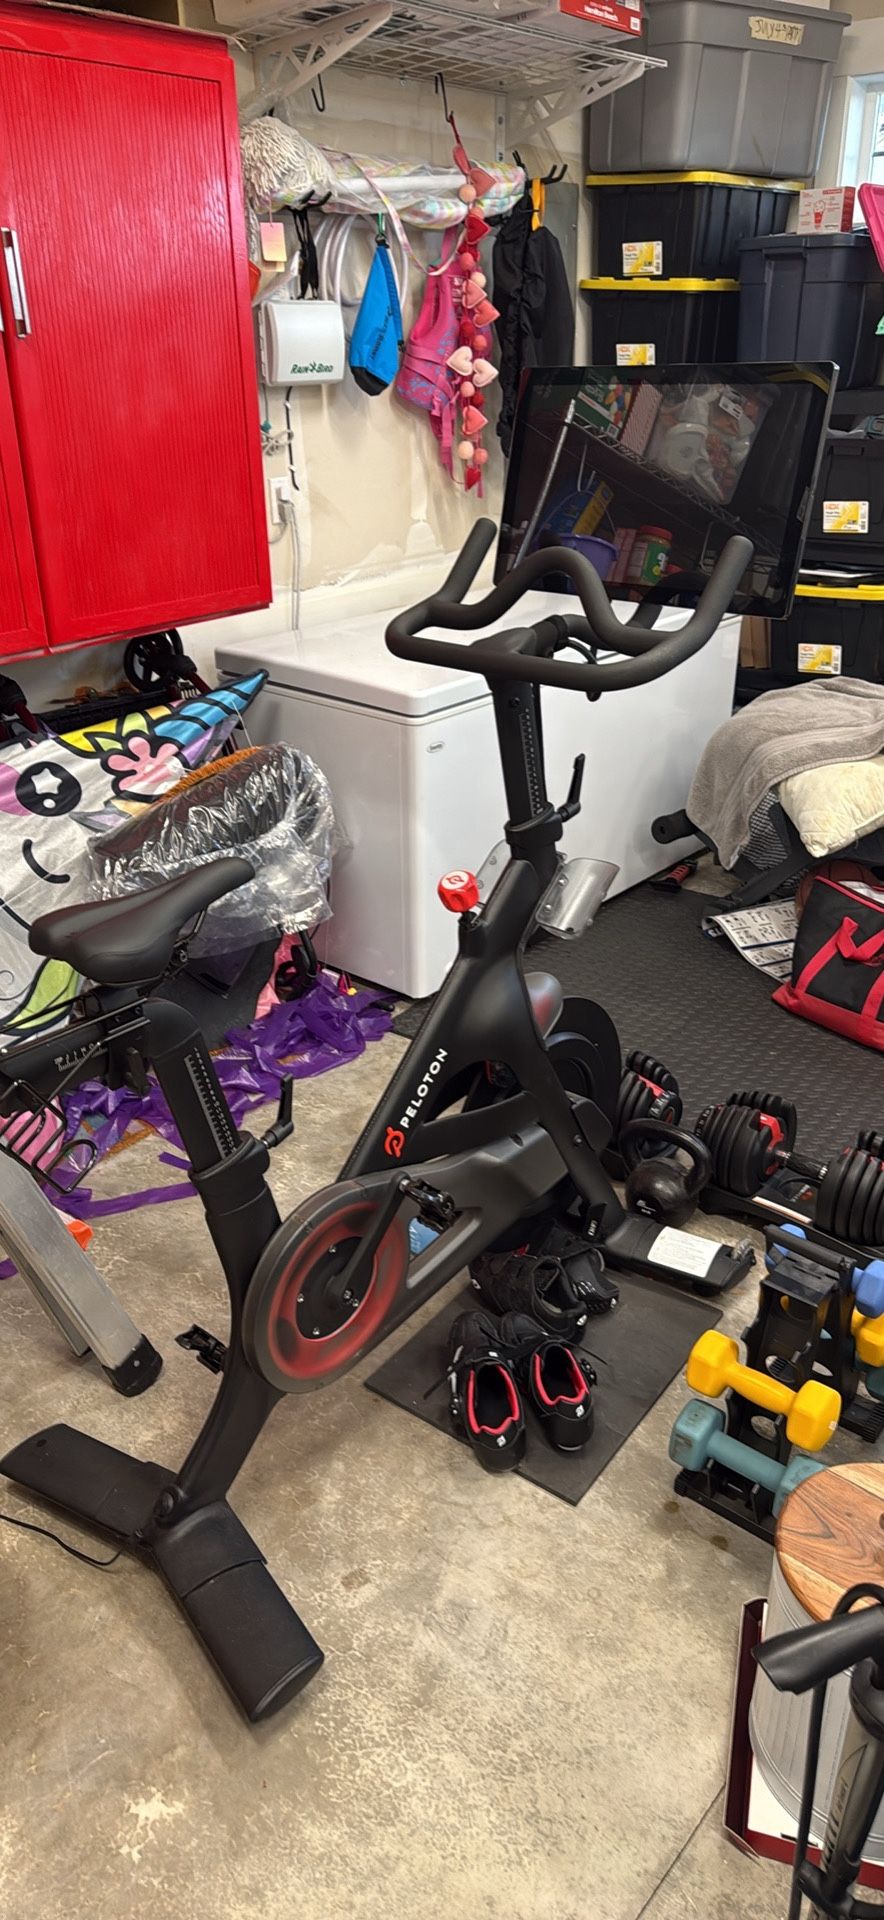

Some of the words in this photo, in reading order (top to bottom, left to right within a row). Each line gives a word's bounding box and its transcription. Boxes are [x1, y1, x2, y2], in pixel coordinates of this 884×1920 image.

[290, 364, 309, 374] RAIN
[316, 363, 334, 373] BIRD
[400, 1048, 448, 1128] PELOTON
